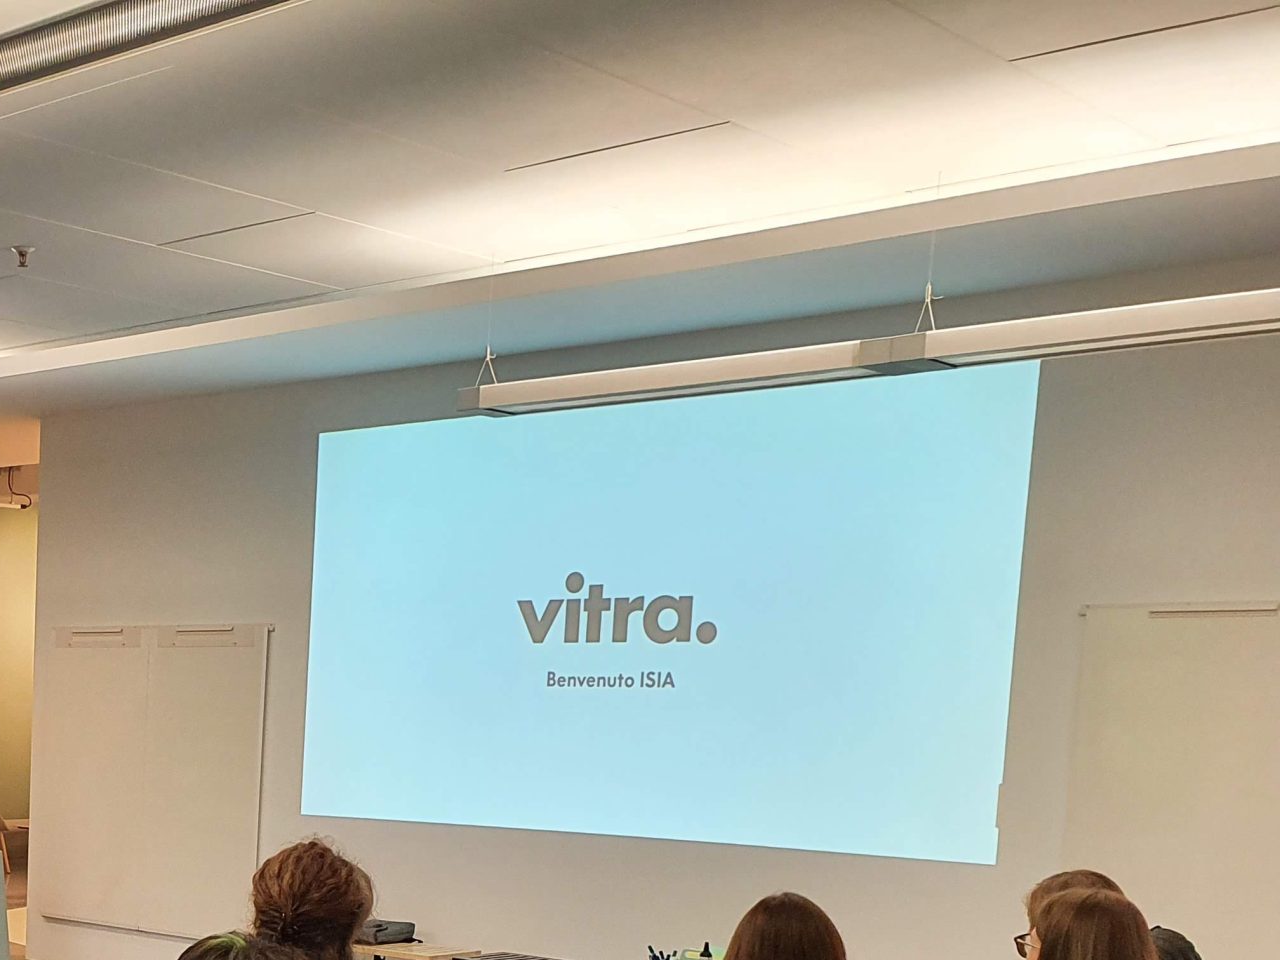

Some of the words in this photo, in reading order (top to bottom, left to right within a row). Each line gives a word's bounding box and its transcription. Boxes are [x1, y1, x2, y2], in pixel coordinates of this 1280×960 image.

[517, 571, 718, 645] vitra.
[546, 671, 635, 688] Benvenuto
[639, 671, 676, 689] ISIA
